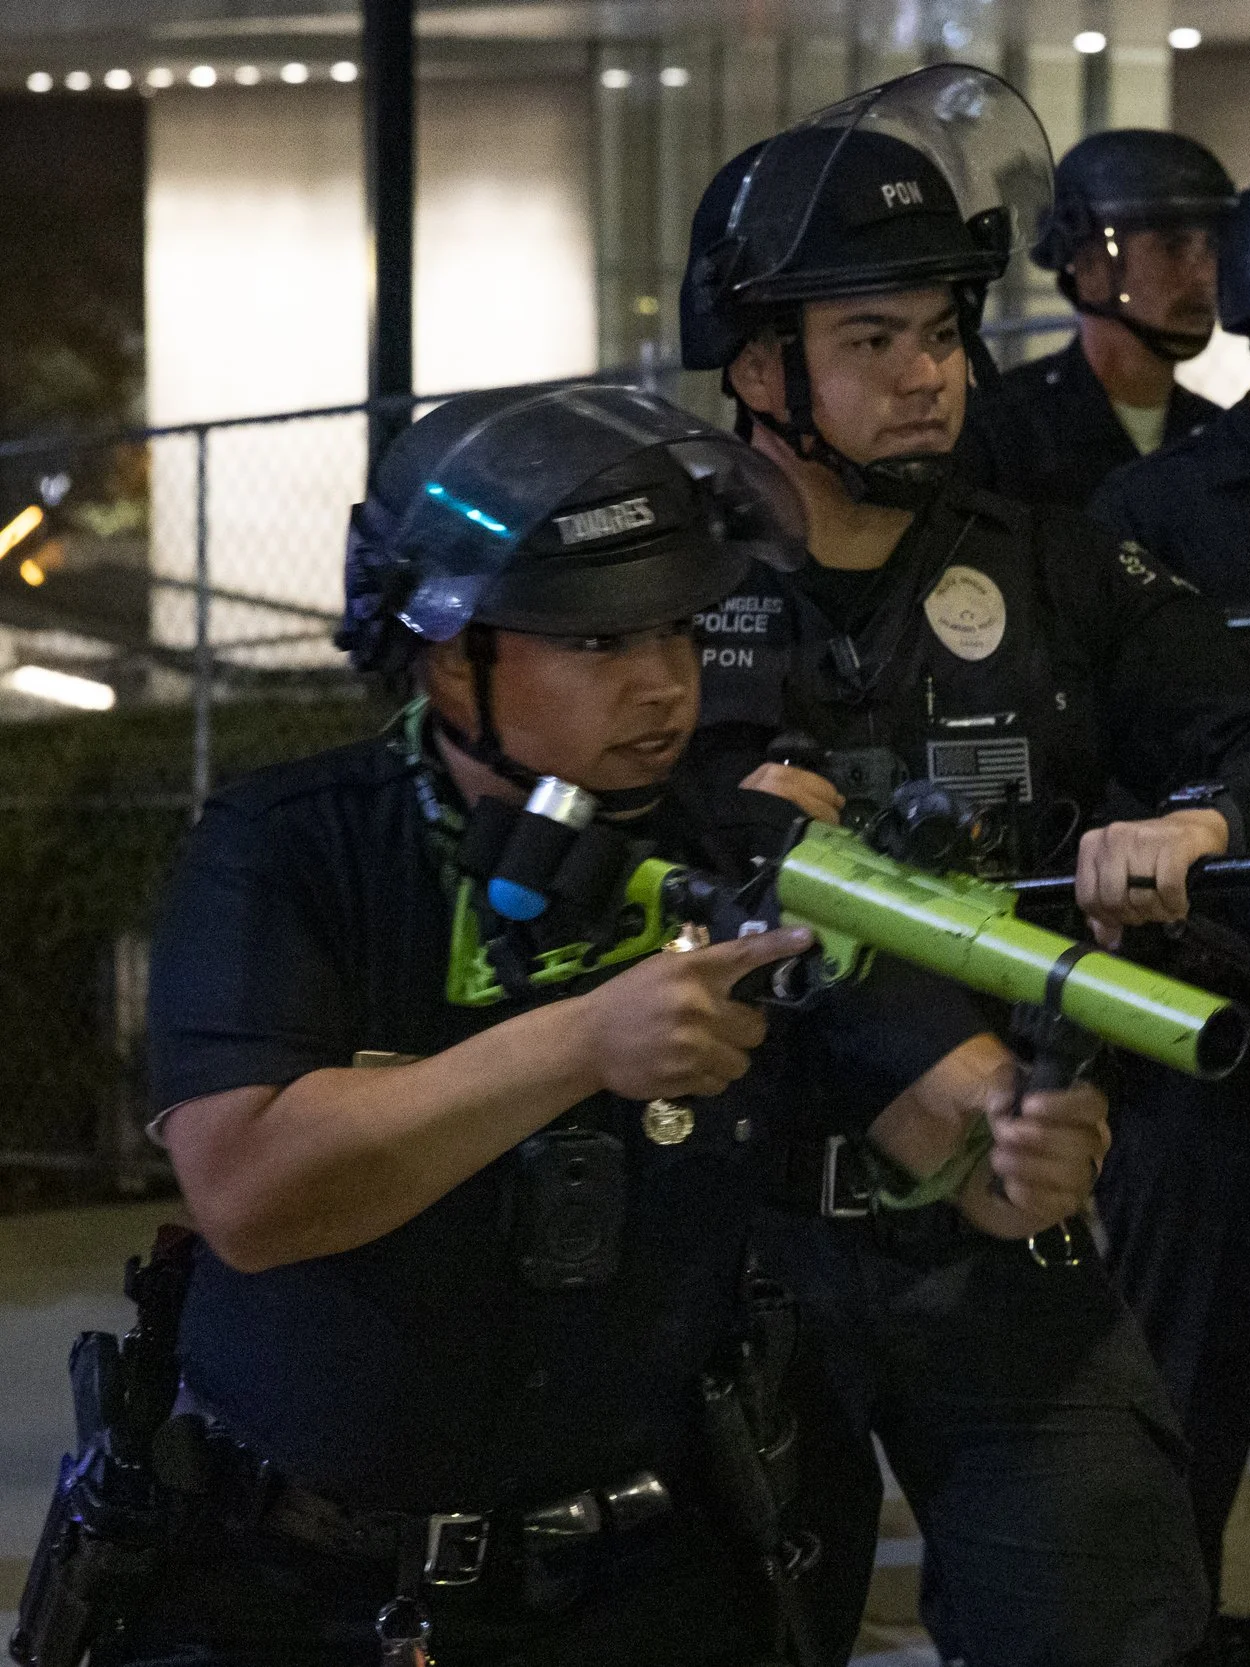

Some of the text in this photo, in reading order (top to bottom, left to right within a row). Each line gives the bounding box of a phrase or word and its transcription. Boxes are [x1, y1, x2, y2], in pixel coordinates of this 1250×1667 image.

[881, 181, 923, 208] PON
[719, 596, 783, 613] NGELES
[693, 612, 769, 633] POLICE
[702, 648, 754, 668] PON
